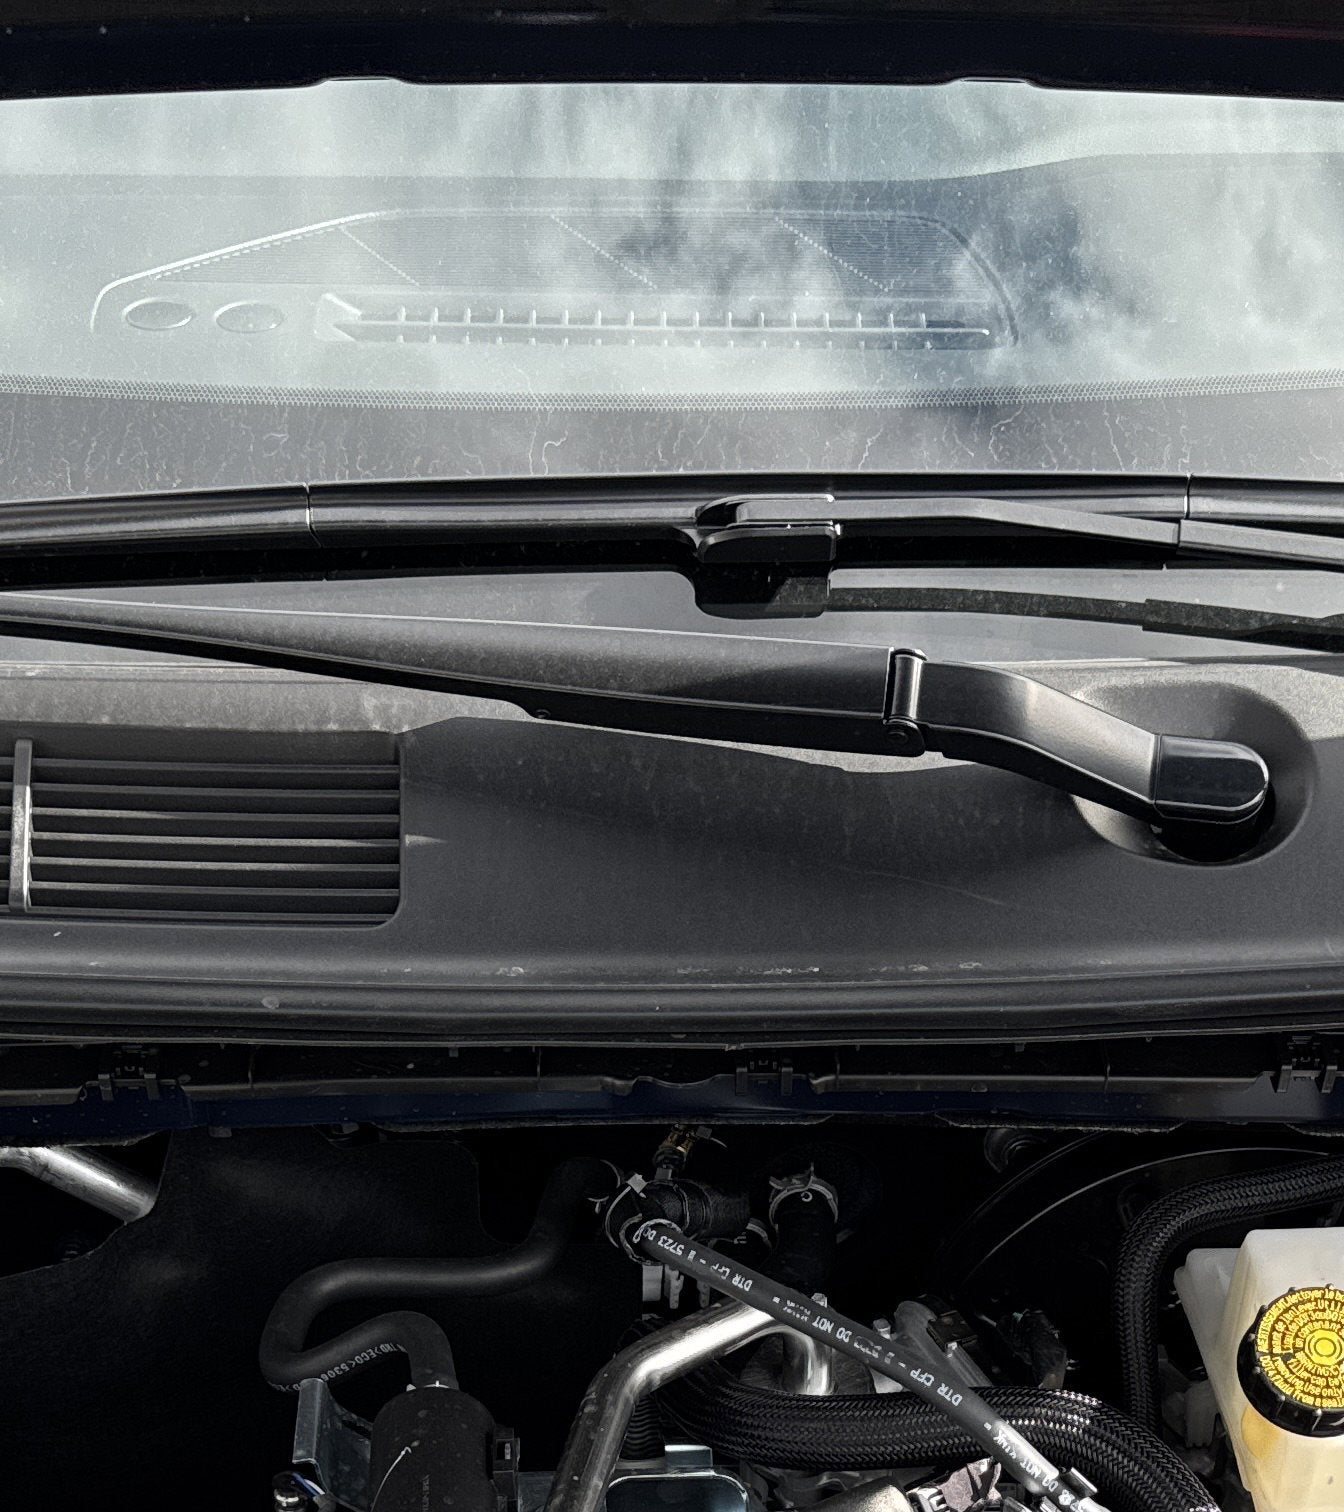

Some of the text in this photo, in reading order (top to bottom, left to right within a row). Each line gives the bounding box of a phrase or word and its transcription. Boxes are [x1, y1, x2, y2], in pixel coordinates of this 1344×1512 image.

[657, 1237, 684, 1256] 5723
[812, 1316, 835, 1333] NOT
[836, 1327, 852, 1343] DO
[937, 1383, 963, 1407] DTR
[1322, 1388, 1343, 1401] only
